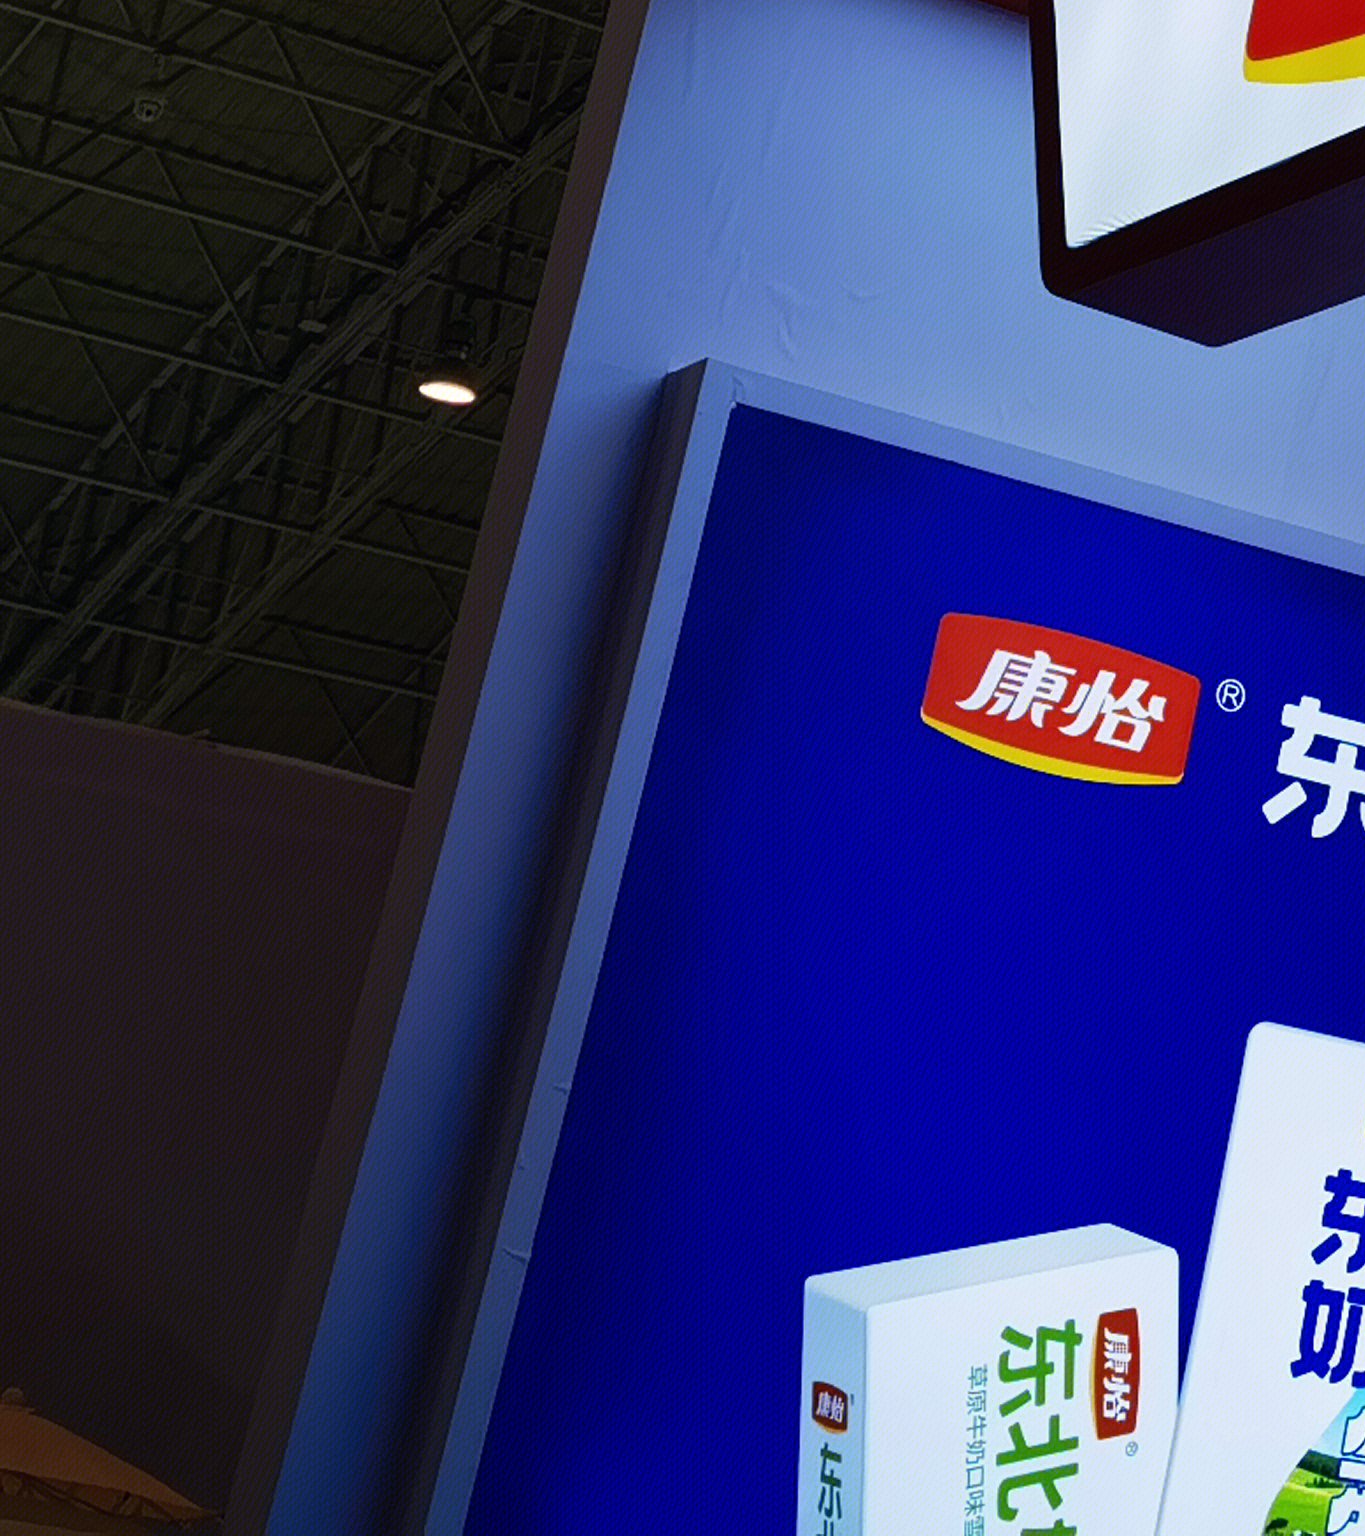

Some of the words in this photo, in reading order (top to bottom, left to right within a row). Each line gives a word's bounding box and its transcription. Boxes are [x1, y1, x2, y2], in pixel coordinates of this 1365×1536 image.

[956, 649, 1170, 754] 康怡
[996, 1319, 1083, 1536] 东北
[1103, 1327, 1132, 1424] 康怡
